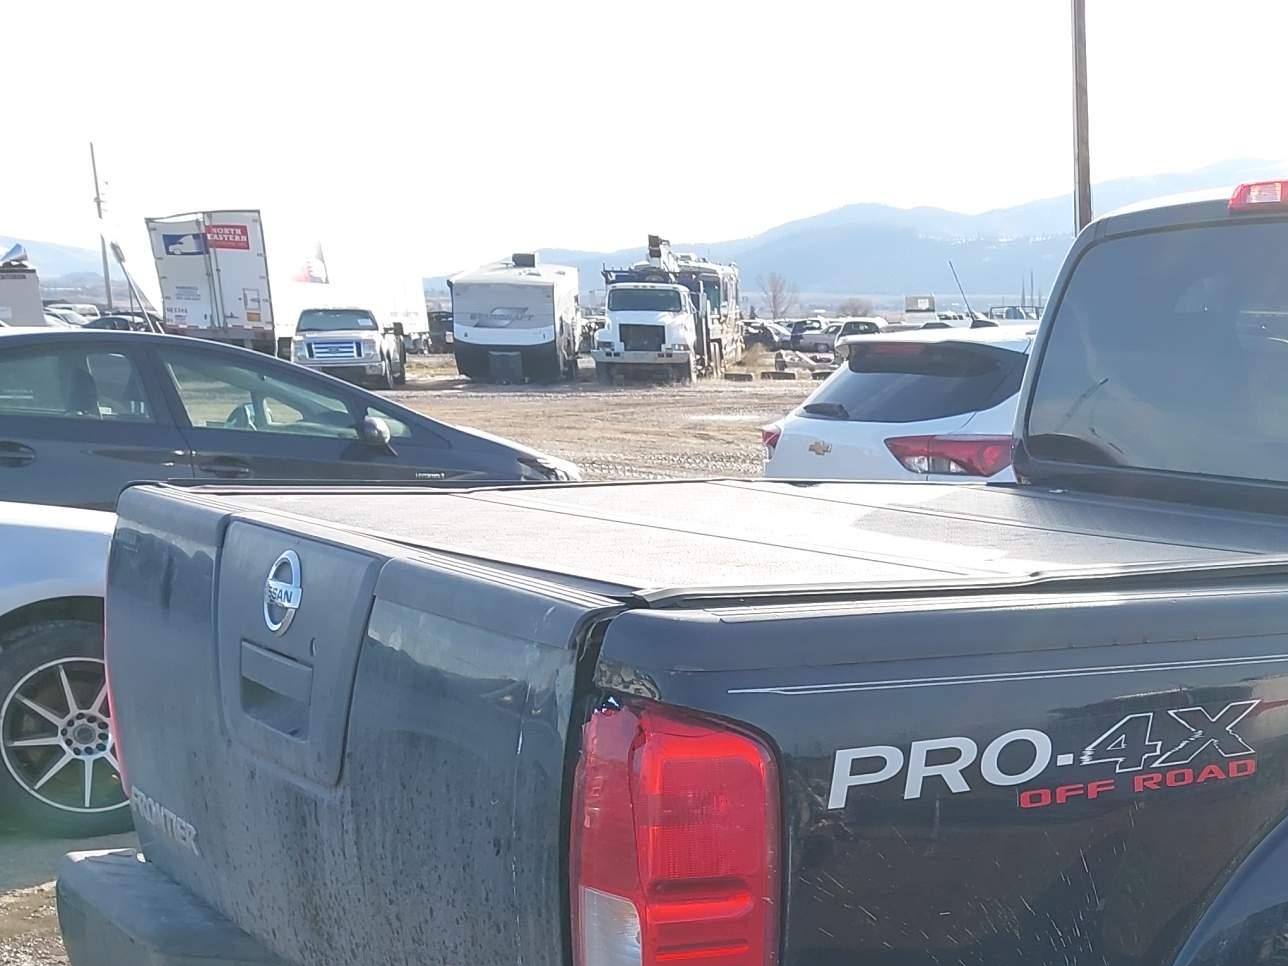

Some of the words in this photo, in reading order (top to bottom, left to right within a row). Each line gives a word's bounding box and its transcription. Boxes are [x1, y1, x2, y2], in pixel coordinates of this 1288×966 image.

[207, 233, 248, 242] EASTERN
[827, 699, 1262, 810] PRO-4X
[1020, 779, 1116, 809] OFF
[1134, 759, 1257, 793] ROAD
[131, 784, 200, 857] FRONTIER
